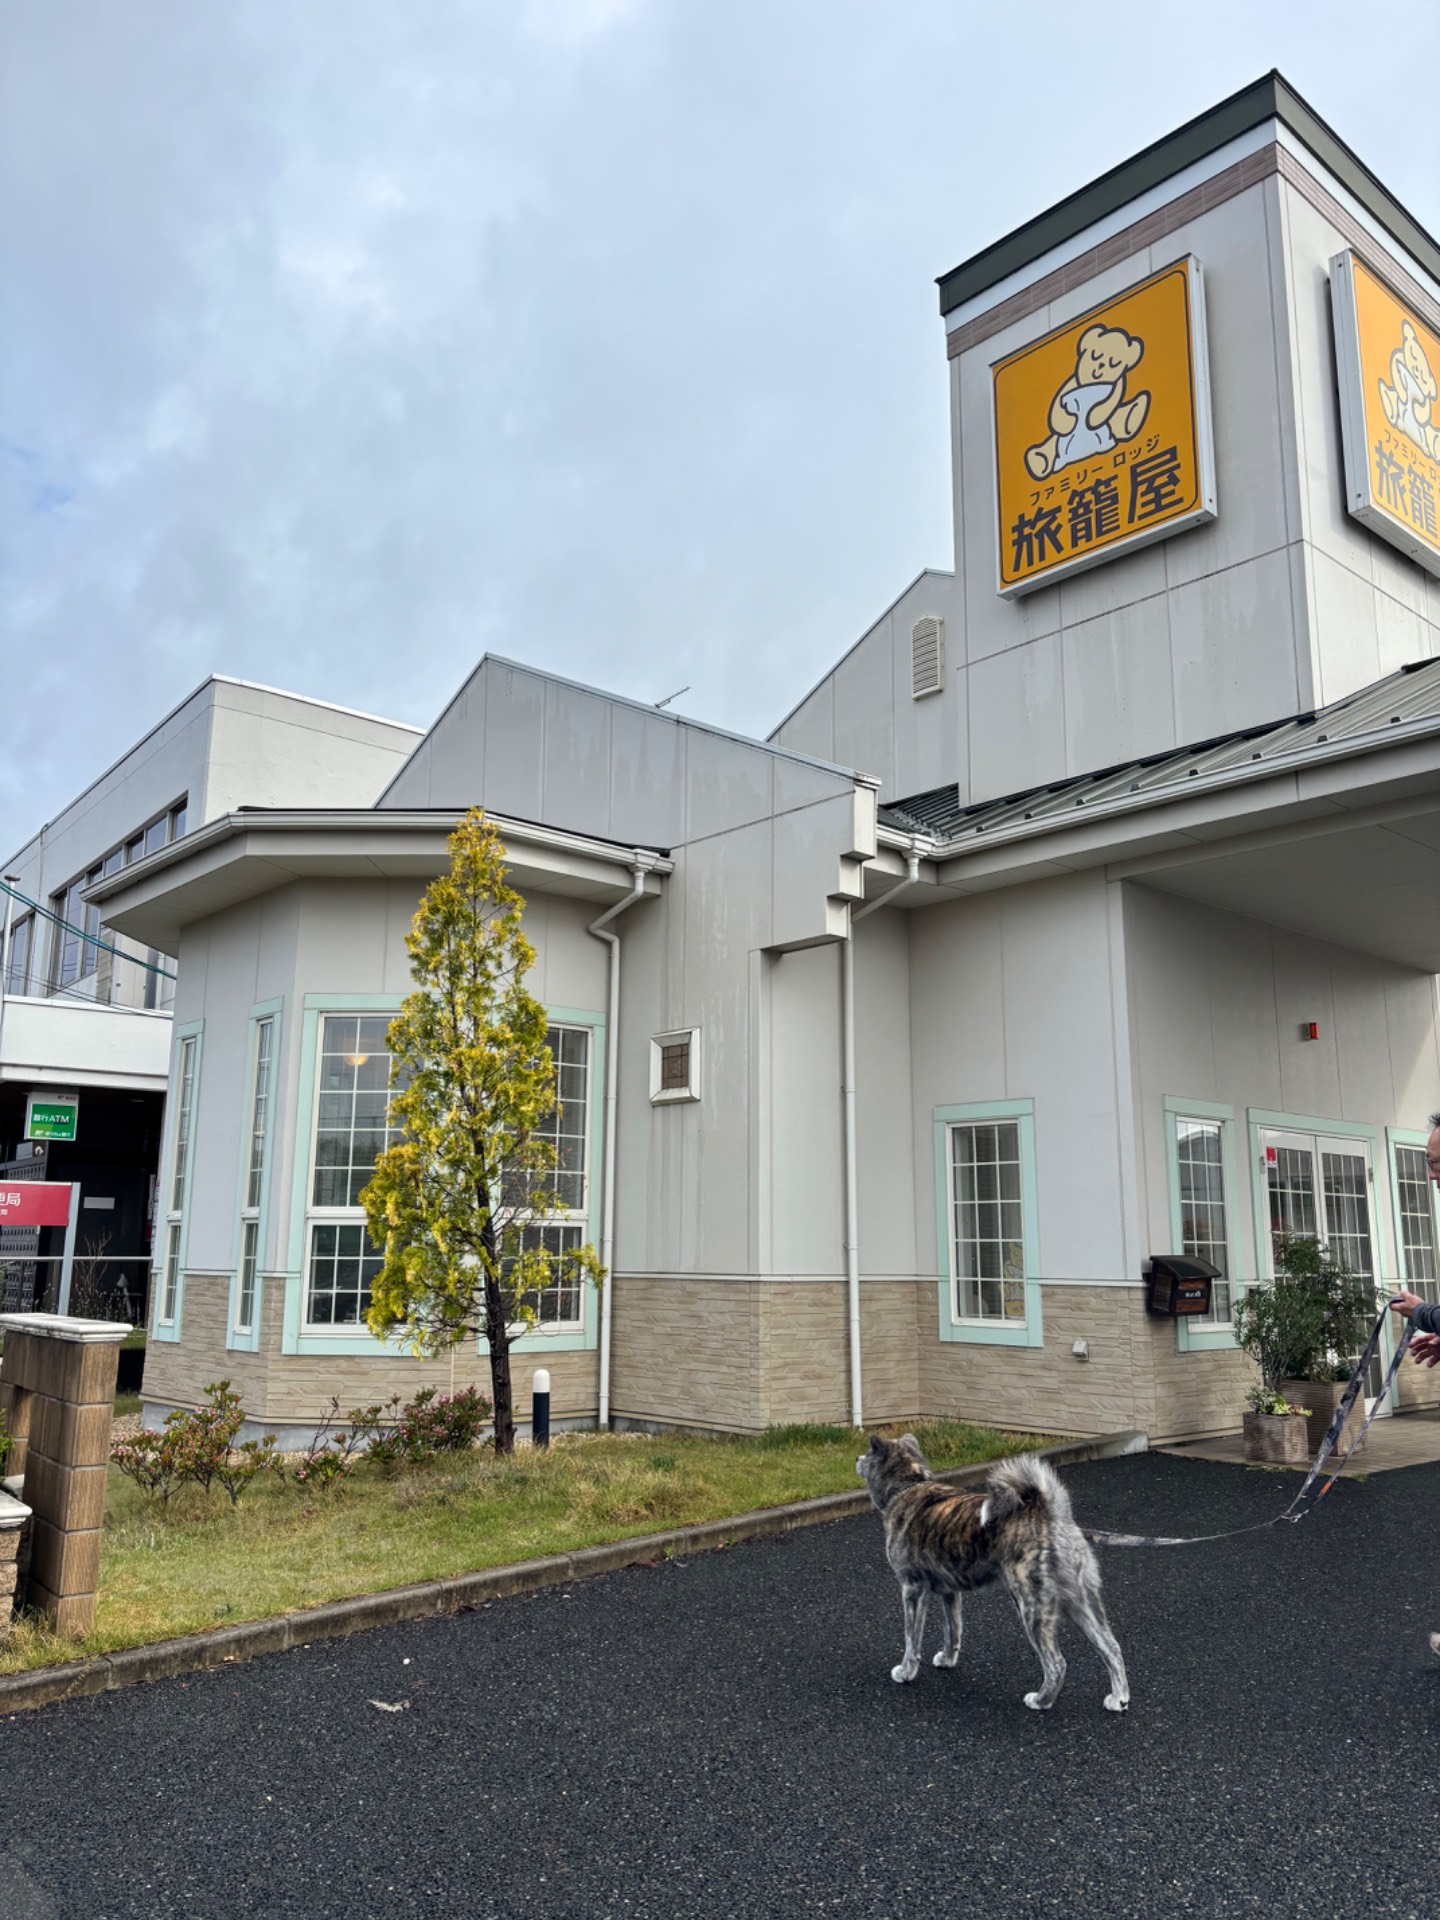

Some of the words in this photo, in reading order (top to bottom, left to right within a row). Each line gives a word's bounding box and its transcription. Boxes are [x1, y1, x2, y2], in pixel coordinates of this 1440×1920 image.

[1030, 466, 1103, 506] ファミリー
[1113, 433, 1160, 468] ロッジ
[1375, 440, 1440, 539] 旅籠
[1384, 429, 1425, 468] ファミリー
[1012, 445, 1184, 572] 旅籠屋
